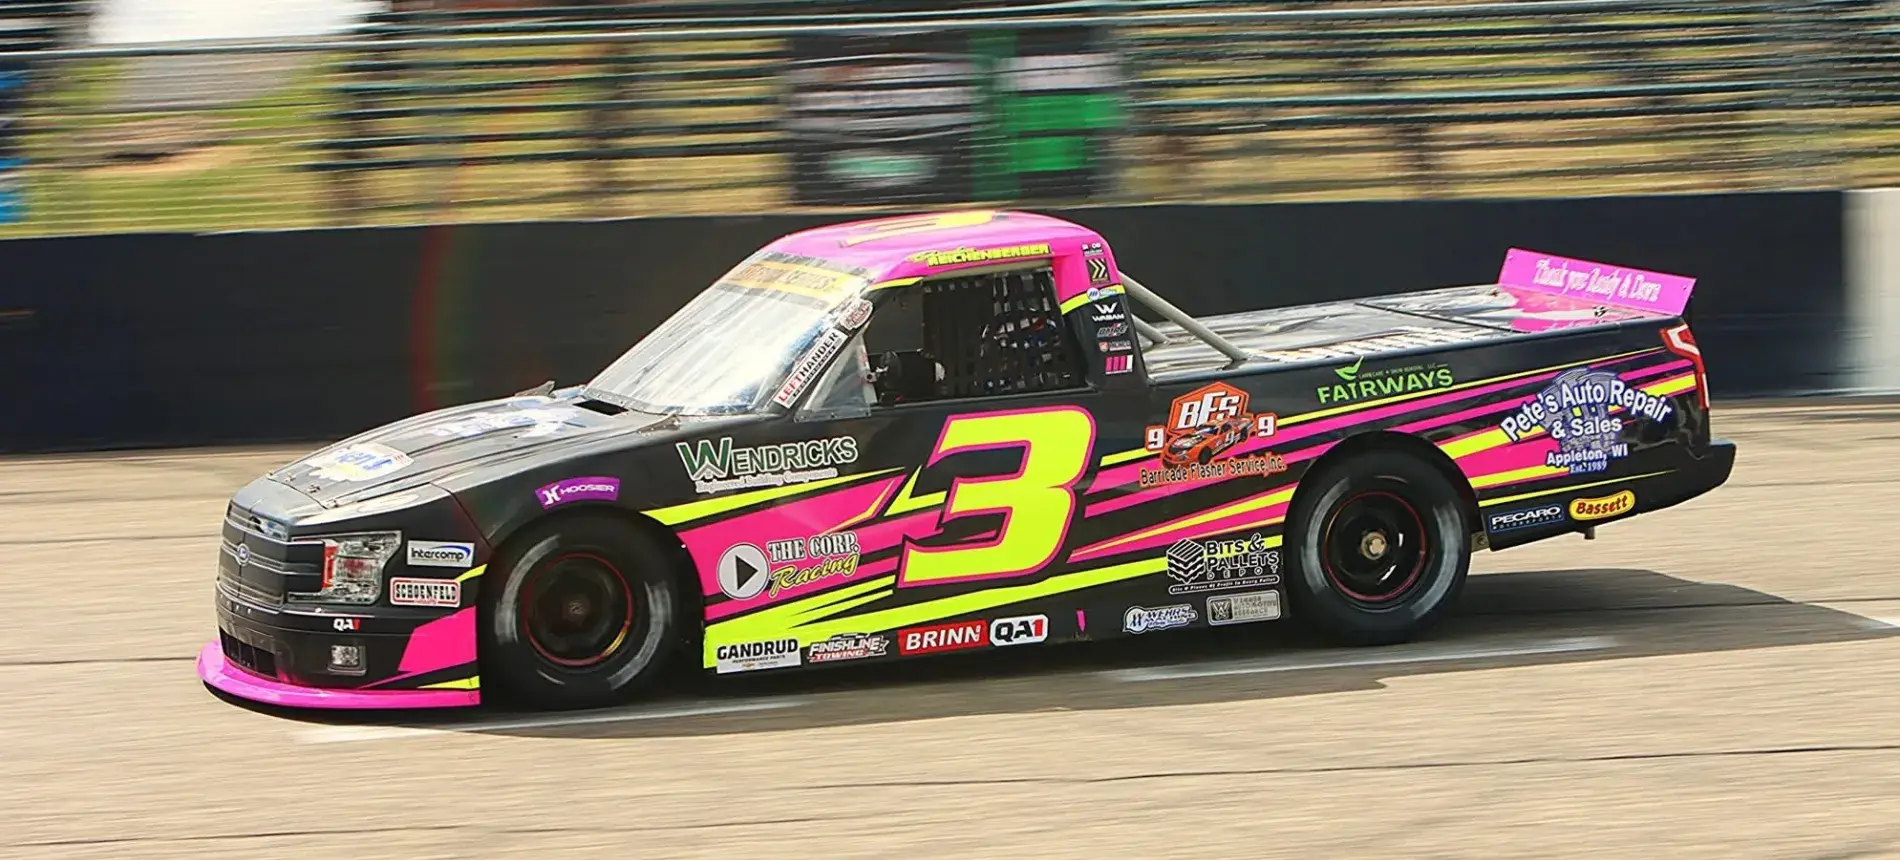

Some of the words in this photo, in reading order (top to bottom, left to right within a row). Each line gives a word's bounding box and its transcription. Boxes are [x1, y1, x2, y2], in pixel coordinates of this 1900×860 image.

[1533, 258, 1567, 288] Thank
[1619, 273, 1632, 298] &
[778, 332, 839, 402] LEFTHANDER
[1317, 368, 1454, 404] FAIRWAYS
[1177, 391, 1241, 430] BFS
[1500, 392, 1560, 442] Pete's
[1562, 379, 1605, 408] Auto
[1610, 379, 1673, 422] Repair
[1257, 415, 1275, 437] 9
[1551, 419, 1567, 439] &
[1571, 416, 1623, 436] Sales
[1147, 428, 1165, 450] 9
[676, 436, 859, 481] WENDRICKS
[1546, 449, 1607, 467] Appleton,
[1611, 444, 1628, 458] WI
[1586, 460, 1607, 472] 1989
[1140, 464, 1188, 485] Barricade
[1190, 460, 1226, 479] Flasher
[560, 484, 615, 495] HOOSIER
[897, 405, 1097, 588] 3
[1491, 507, 1561, 525] PECARO
[1576, 495, 1628, 515] Bassett
[411, 547, 465, 563] Intercomp
[767, 537, 806, 562] THE
[809, 531, 860, 557] CORP.
[1205, 539, 1245, 556] BITS
[1248, 532, 1265, 552] &
[1205, 551, 1279, 572] PALLETS
[1207, 564, 1278, 580] DEPOT
[769, 553, 859, 598] Racing
[395, 584, 456, 600] SCHOENFELD
[333, 618, 361, 632] QA1
[995, 619, 1044, 642] QA1
[716, 638, 799, 660] GANDRUD
[809, 635, 879, 657] FINISHLINE
[906, 625, 982, 650] BRINN
[812, 650, 867, 662] TOWING
